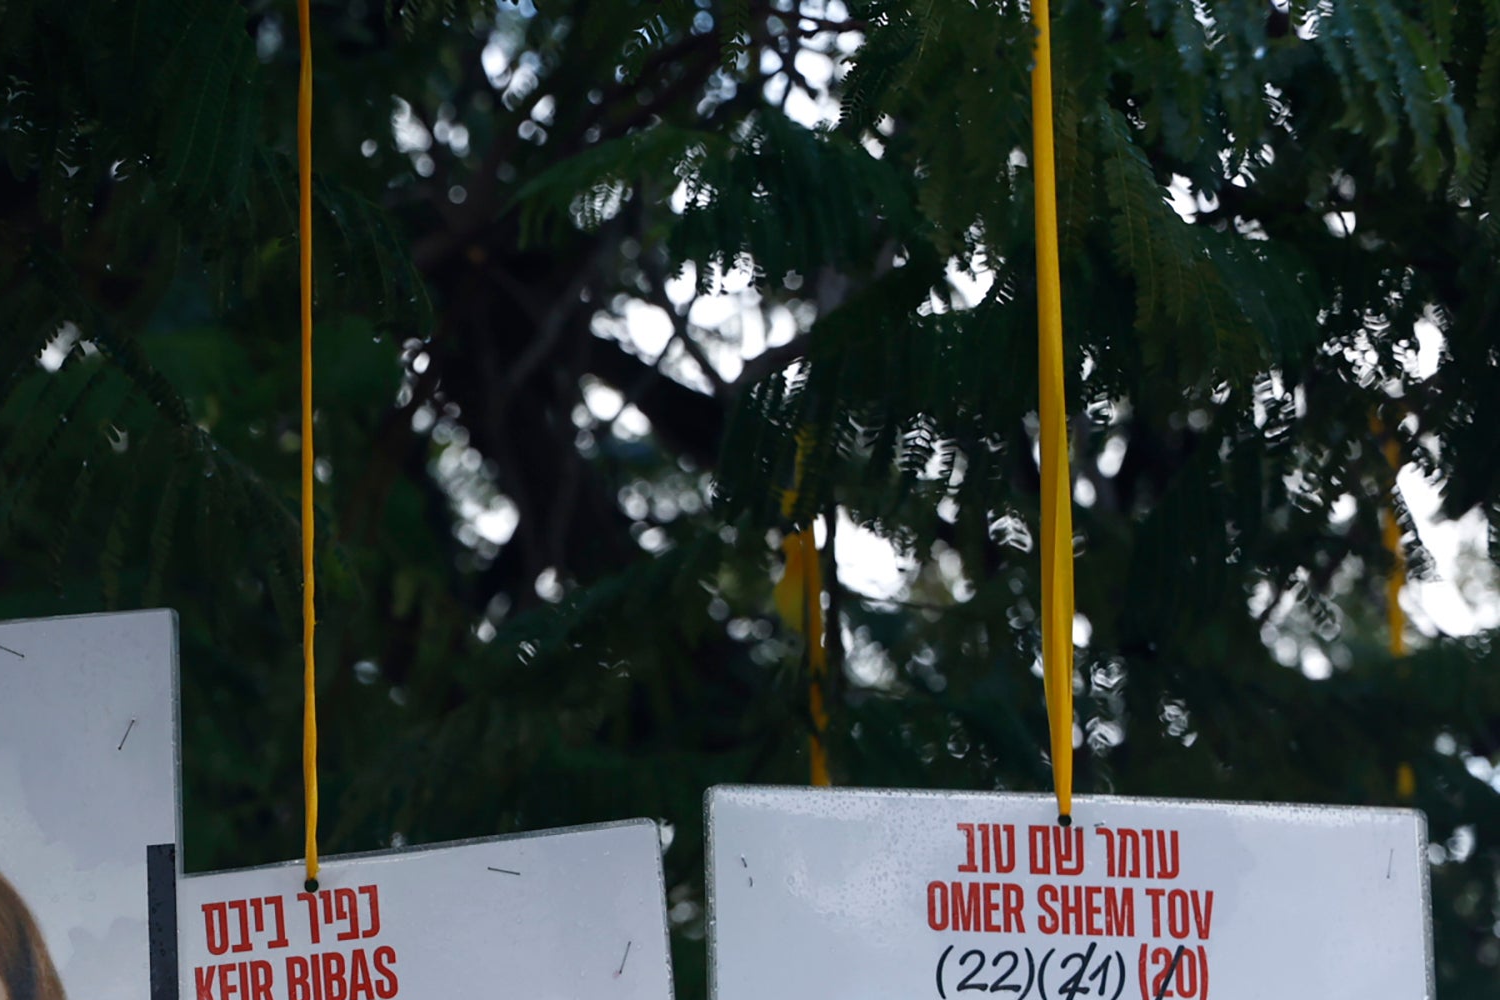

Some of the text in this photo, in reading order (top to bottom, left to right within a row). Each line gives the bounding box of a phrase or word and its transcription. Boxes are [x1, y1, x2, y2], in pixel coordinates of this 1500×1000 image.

[957, 823, 1180, 879] עומר שם טוב
[202, 885, 381, 955] כפיר ביבס
[927, 881, 1214, 940] OMER SHEM TOV
